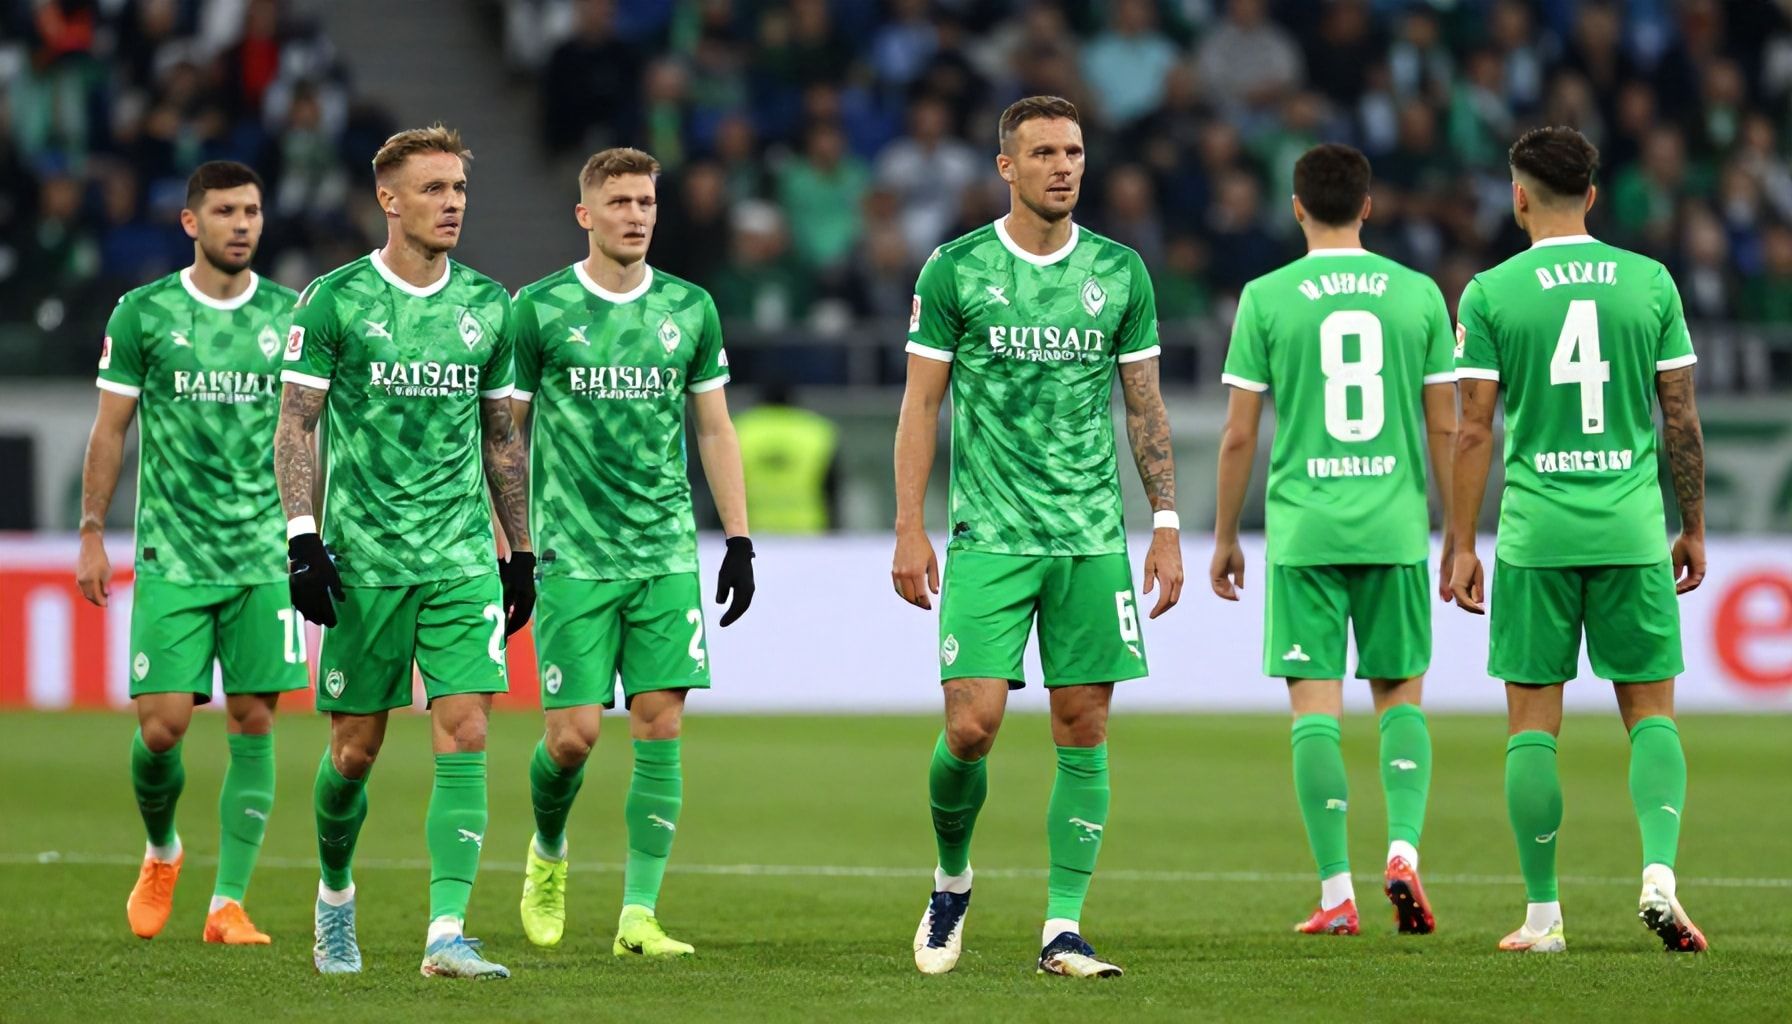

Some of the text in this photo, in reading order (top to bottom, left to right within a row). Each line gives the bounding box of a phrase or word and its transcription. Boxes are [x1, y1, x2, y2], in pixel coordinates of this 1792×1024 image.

[1321, 310, 1384, 442] 8
[1550, 299, 1610, 434] 4
[483, 603, 505, 665] 2
[686, 608, 705, 662] 2
[1115, 589, 1139, 643] 6
